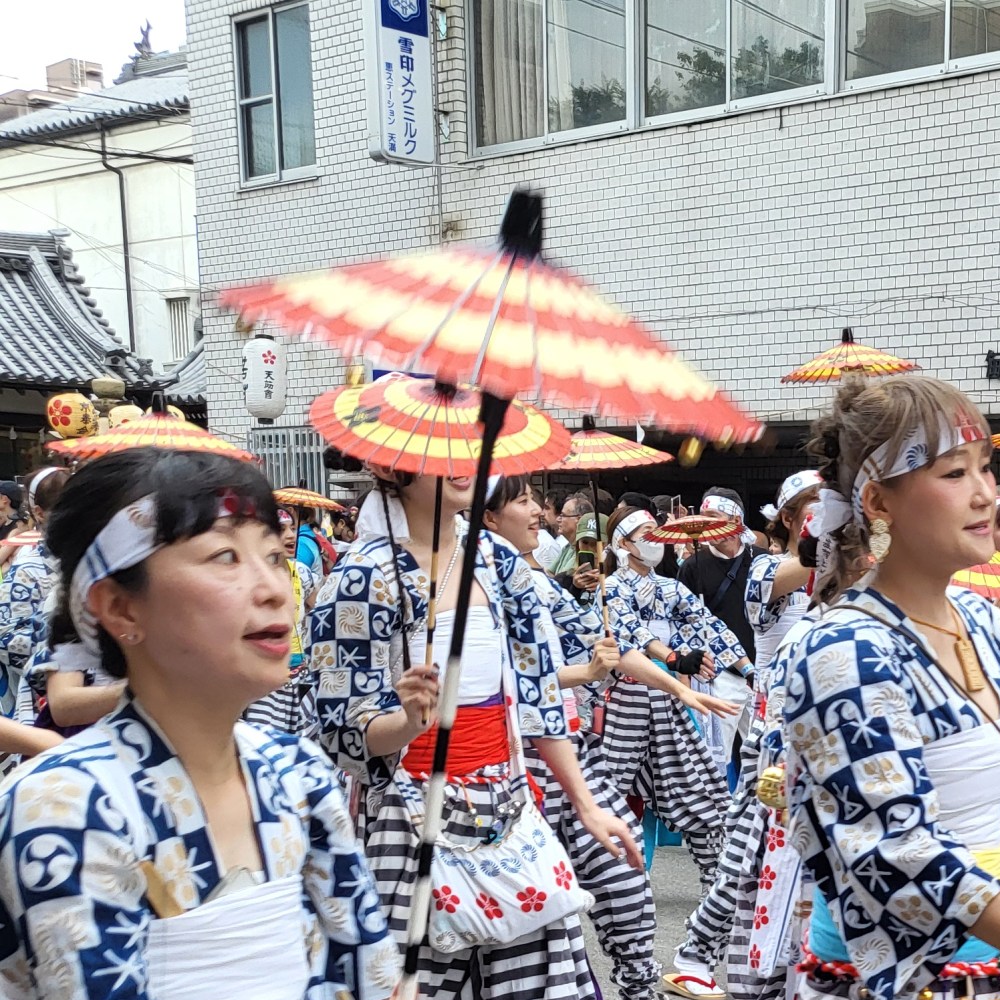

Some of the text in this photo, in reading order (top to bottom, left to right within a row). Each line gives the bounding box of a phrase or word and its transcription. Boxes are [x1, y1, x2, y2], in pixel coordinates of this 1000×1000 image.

[397, 36, 417, 155] 雪印メグミルク
[387, 133, 396, 152] 天満
